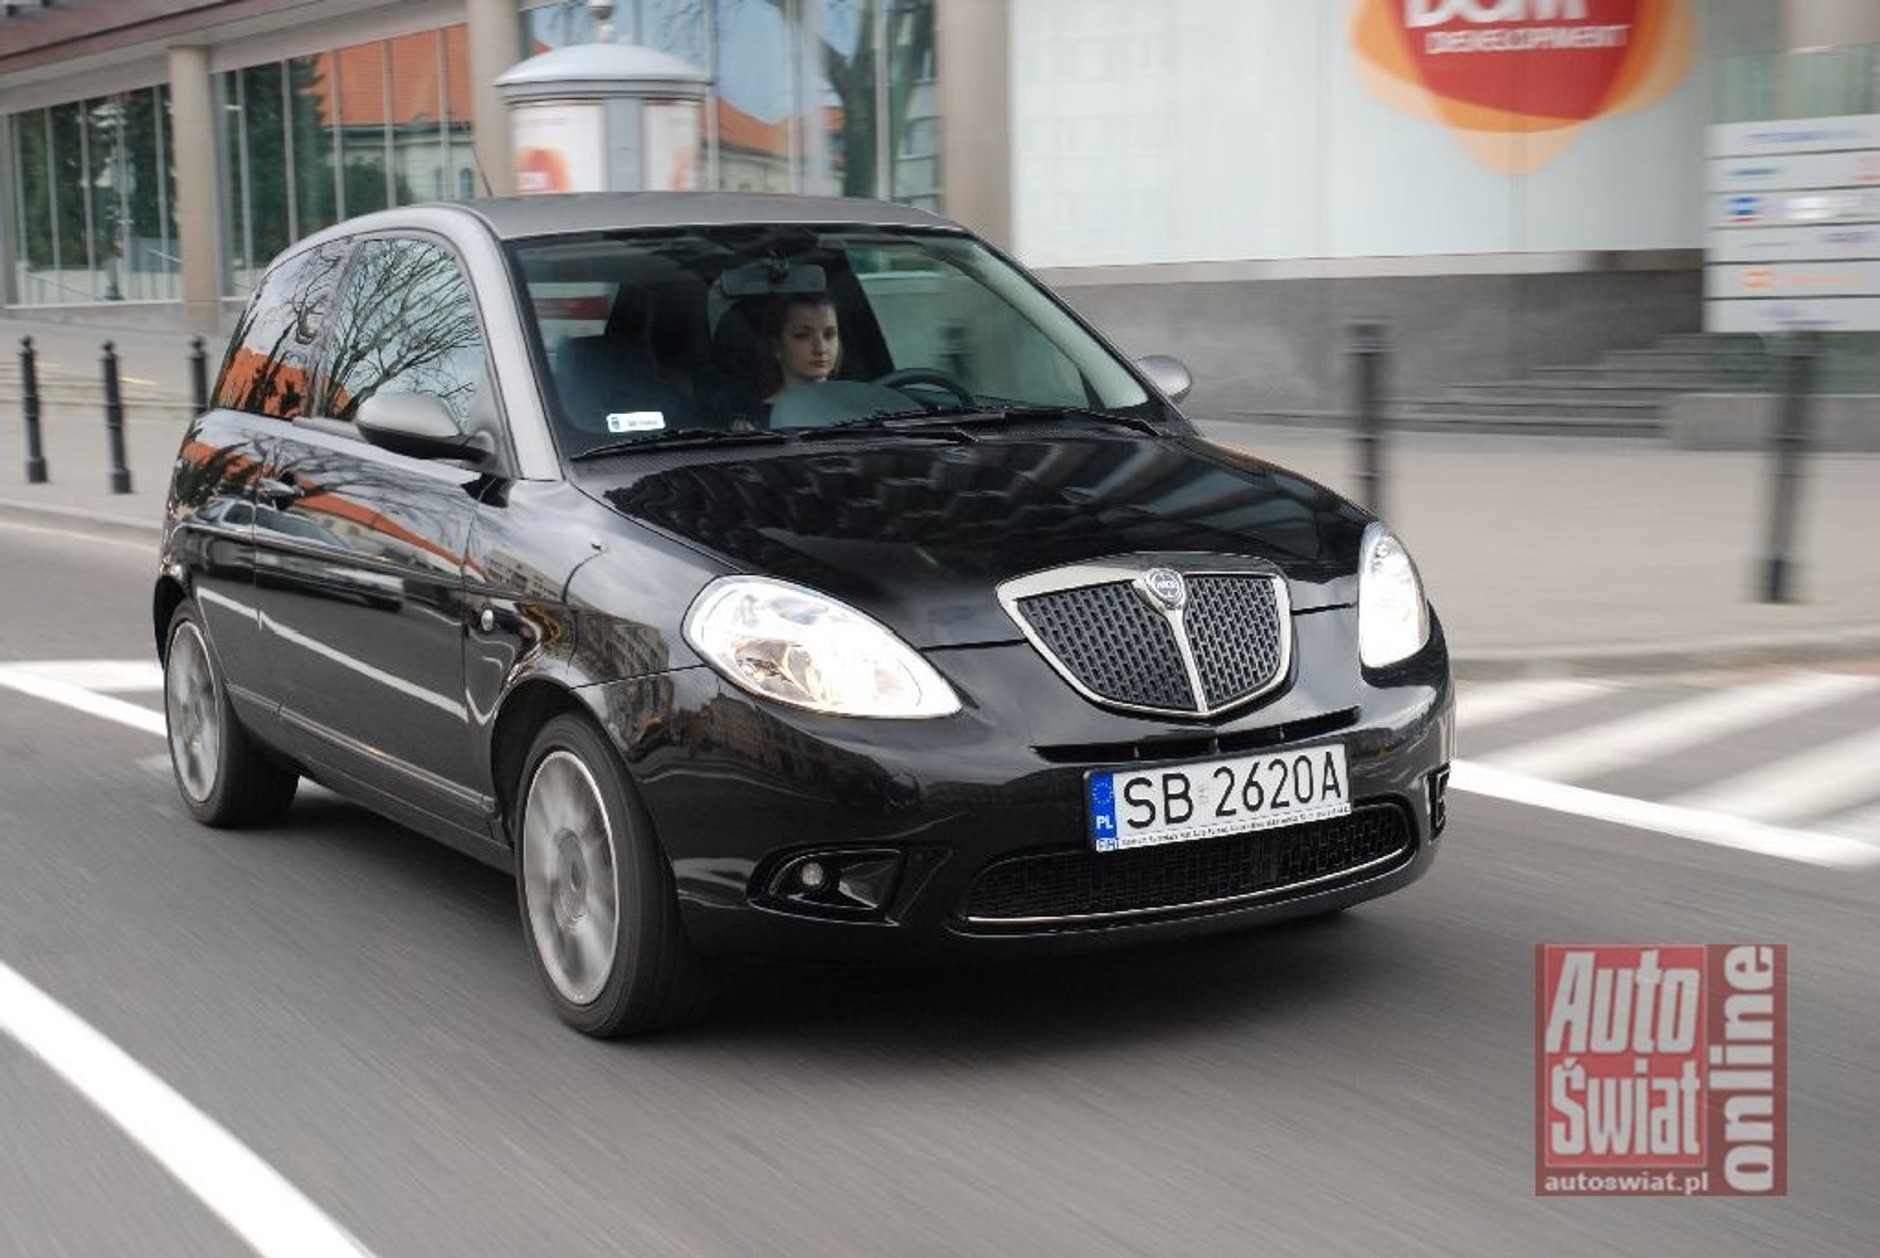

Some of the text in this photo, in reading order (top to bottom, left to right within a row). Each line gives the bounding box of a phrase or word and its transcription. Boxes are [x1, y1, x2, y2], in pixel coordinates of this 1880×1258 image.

[1123, 773, 1194, 829] SB
[1213, 751, 1342, 817] 2620A
[1096, 815, 1114, 830] PL
